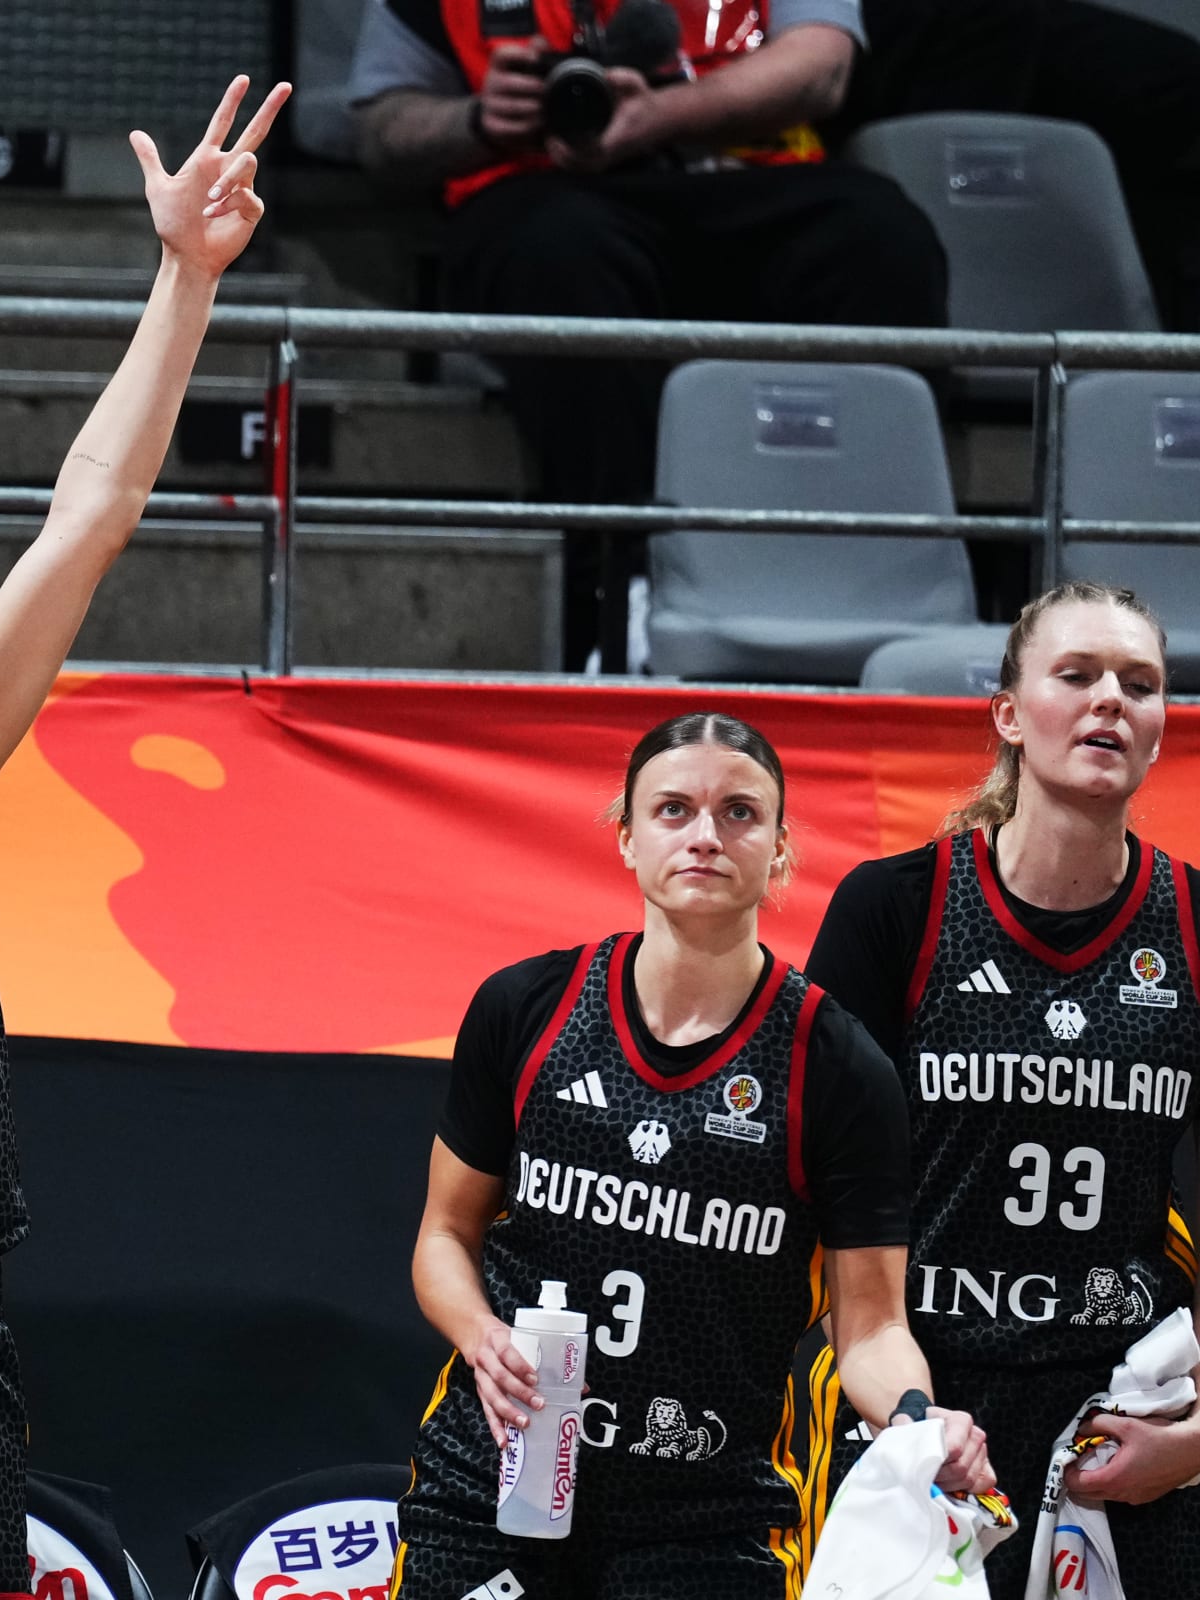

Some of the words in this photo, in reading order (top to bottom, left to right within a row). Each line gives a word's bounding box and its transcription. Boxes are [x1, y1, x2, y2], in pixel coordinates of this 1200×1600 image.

[919, 1052, 1192, 1120] DEUTSCHLAND
[517, 1151, 786, 1256] DEUTSCHLAND
[1003, 1142, 1106, 1231] 33
[595, 1269, 645, 1358] 3
[914, 1264, 1061, 1322] ING
[269, 1520, 399, 1574] 百岁
